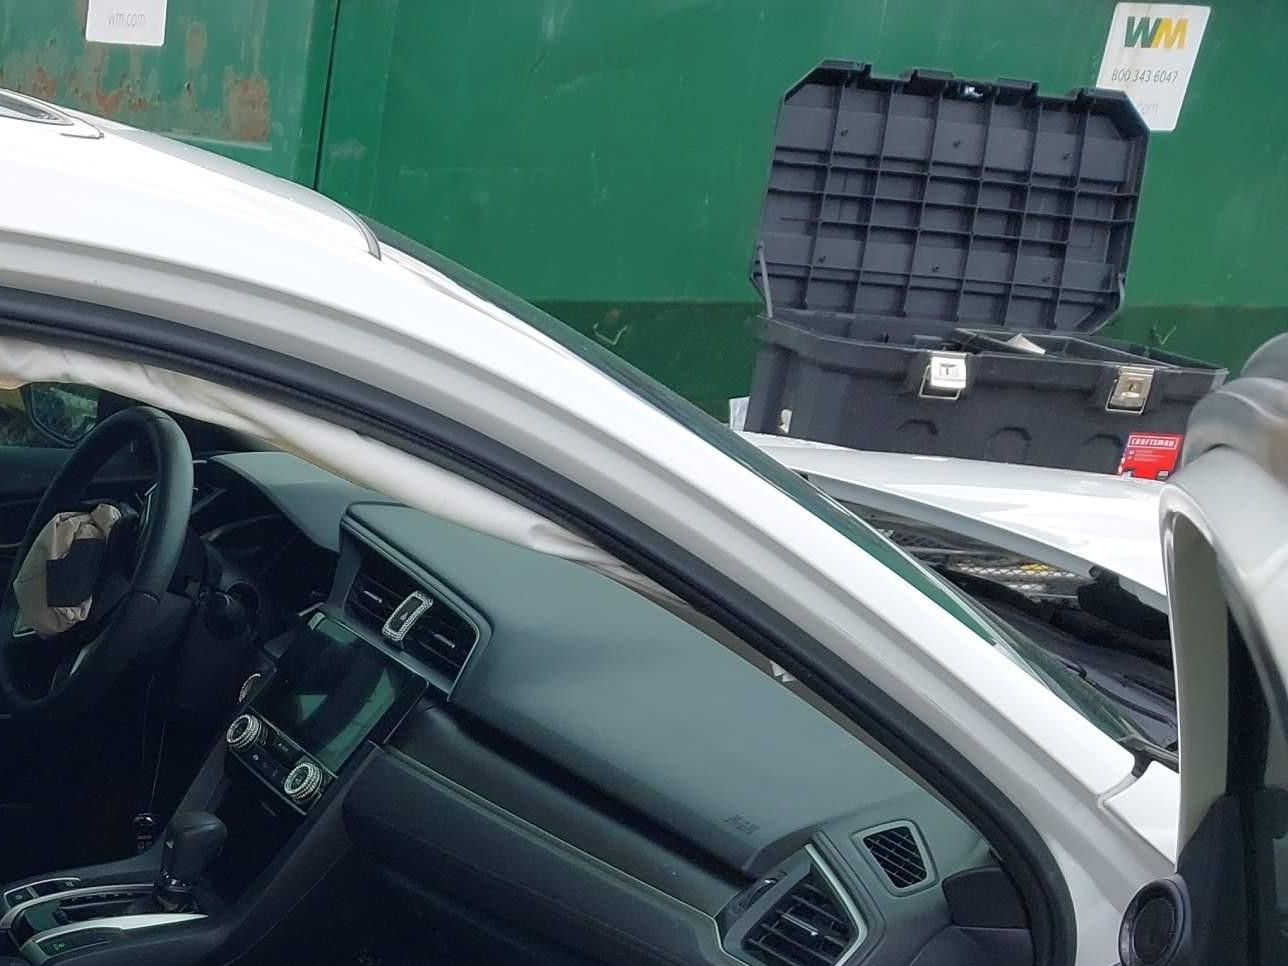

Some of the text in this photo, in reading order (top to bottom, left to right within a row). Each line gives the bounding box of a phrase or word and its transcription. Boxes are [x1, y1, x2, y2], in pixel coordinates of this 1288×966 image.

[106, 13, 146, 27] wm.com
[1124, 16, 1188, 49] WM
[1111, 68, 1180, 83] 800 343 6047
[1131, 438, 1175, 447] CRAFTSMAN
